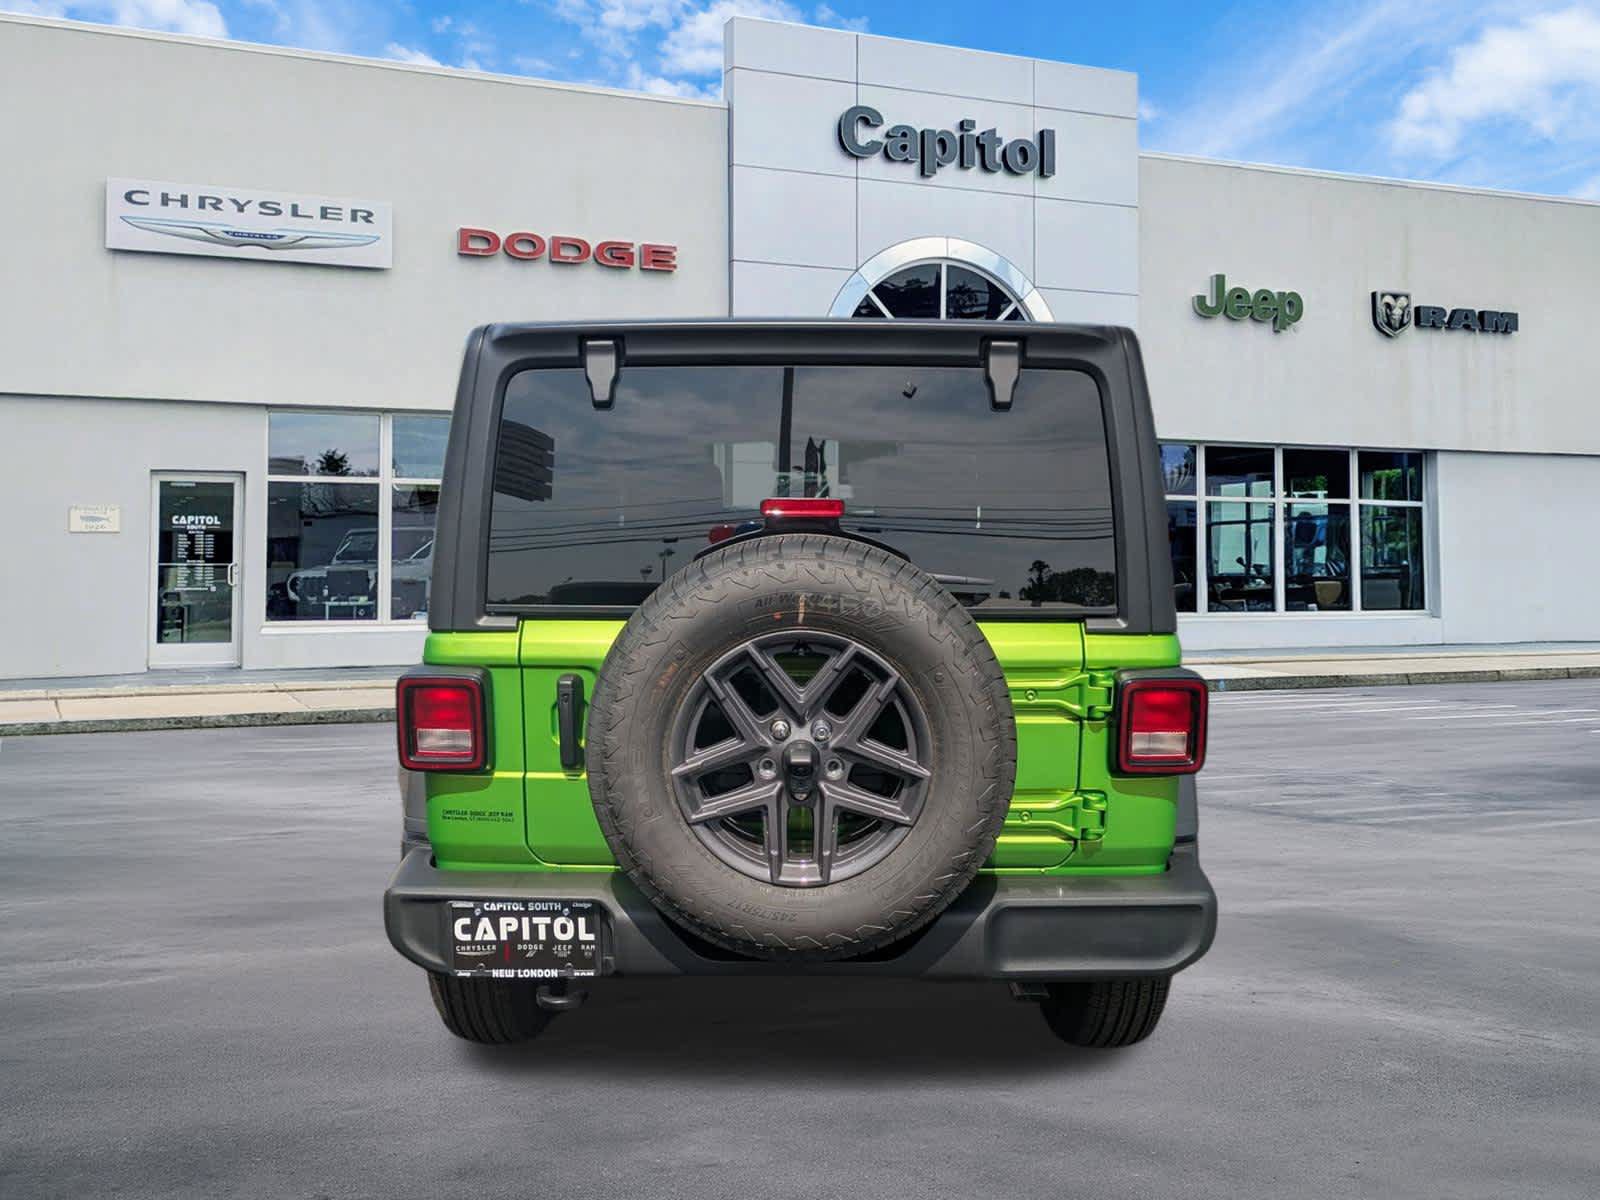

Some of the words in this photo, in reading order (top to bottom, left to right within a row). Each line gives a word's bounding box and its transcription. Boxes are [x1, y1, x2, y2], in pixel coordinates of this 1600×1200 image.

[838, 105, 1056, 177] Capitol
[124, 189, 375, 224] CHRYSLER
[458, 227, 678, 273] DODGE
[1192, 273, 1304, 334] Jeep
[1414, 305, 1519, 334] RAM
[172, 515, 221, 525] CAPITOL
[484, 902, 525, 912] CAPITOL
[528, 902, 561, 912] SOUTH
[454, 917, 595, 941] CAPITOL
[455, 944, 497, 952] CHRYSLER
[492, 968, 514, 978] NEW
[517, 968, 558, 978] LONDON
